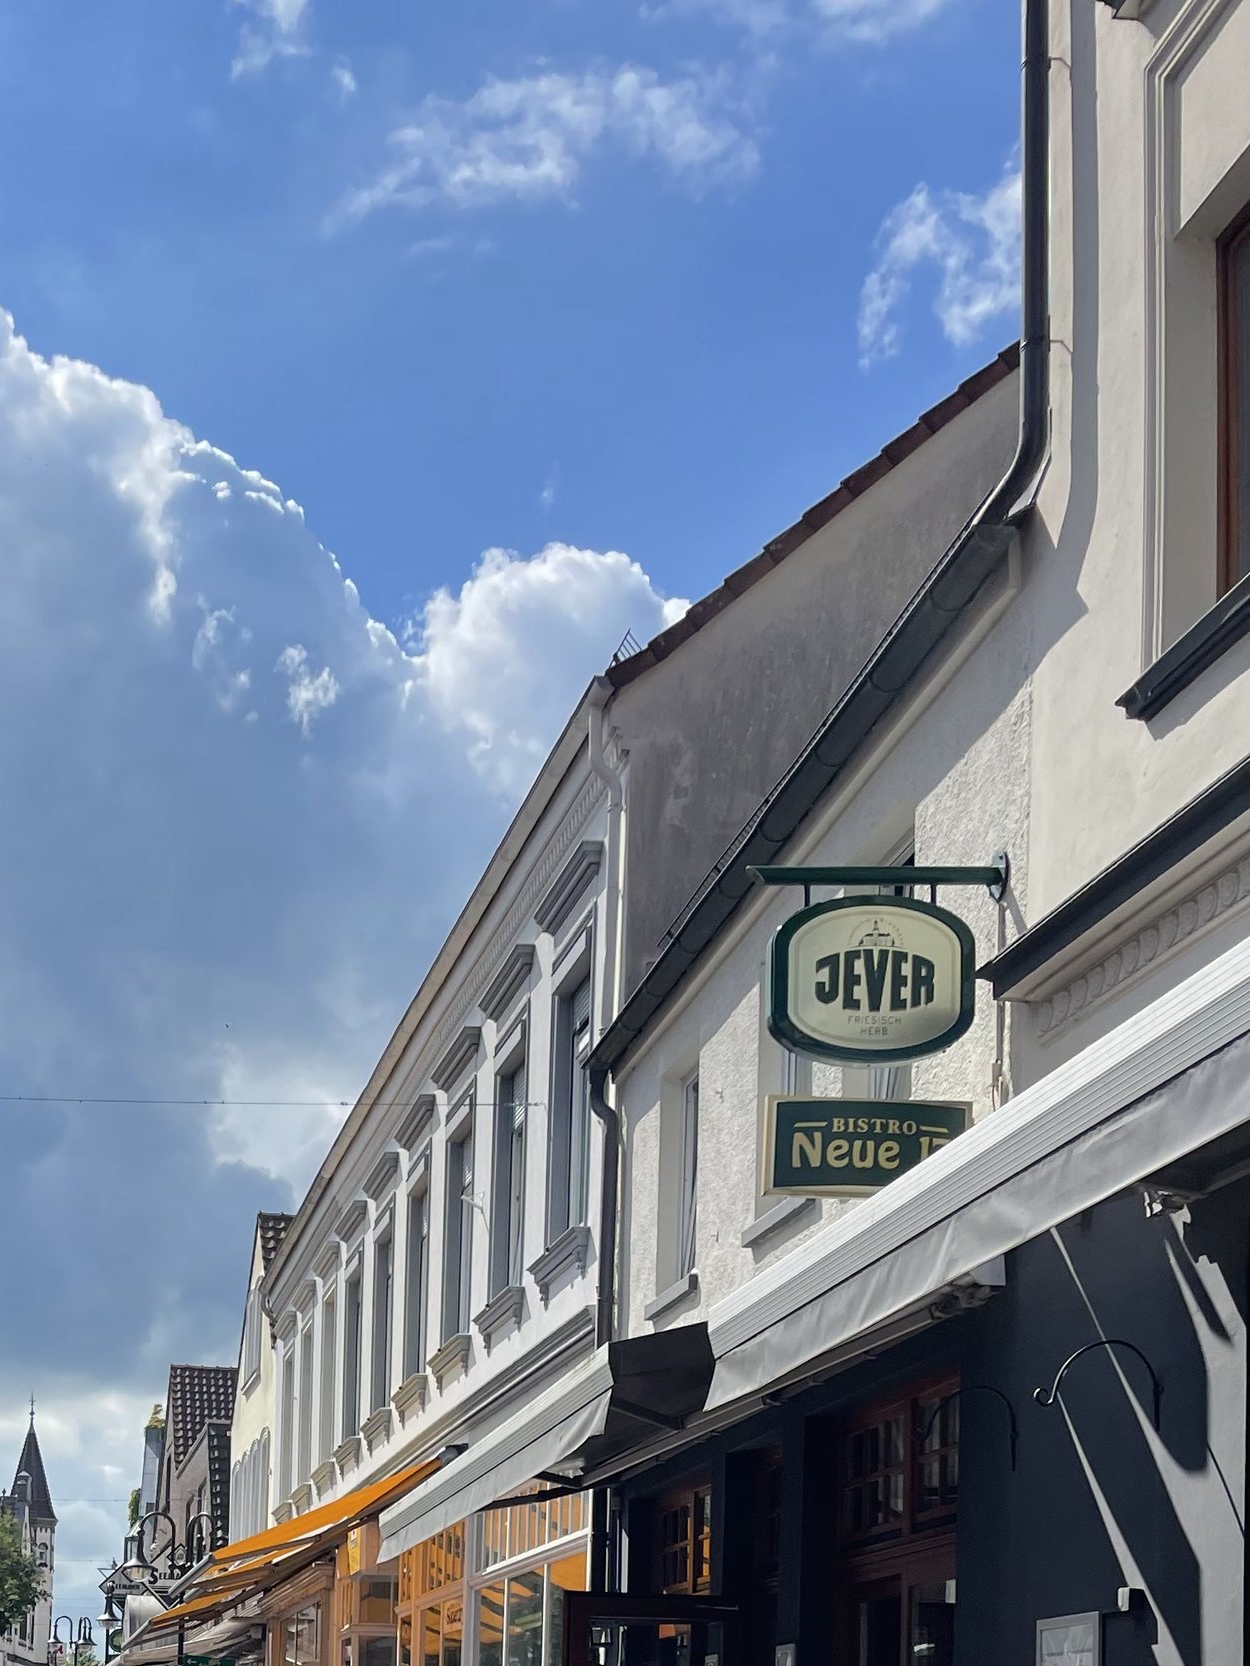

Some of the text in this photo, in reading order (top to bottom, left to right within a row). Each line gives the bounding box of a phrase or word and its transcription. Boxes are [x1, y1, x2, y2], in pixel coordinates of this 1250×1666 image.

[815, 948, 935, 1013] JEVER
[847, 1015, 903, 1026] FRIESISCH
[860, 1026, 889, 1037] HERB
[831, 1117, 917, 1135] BISTRO
[791, 1131, 901, 1170] Neue
